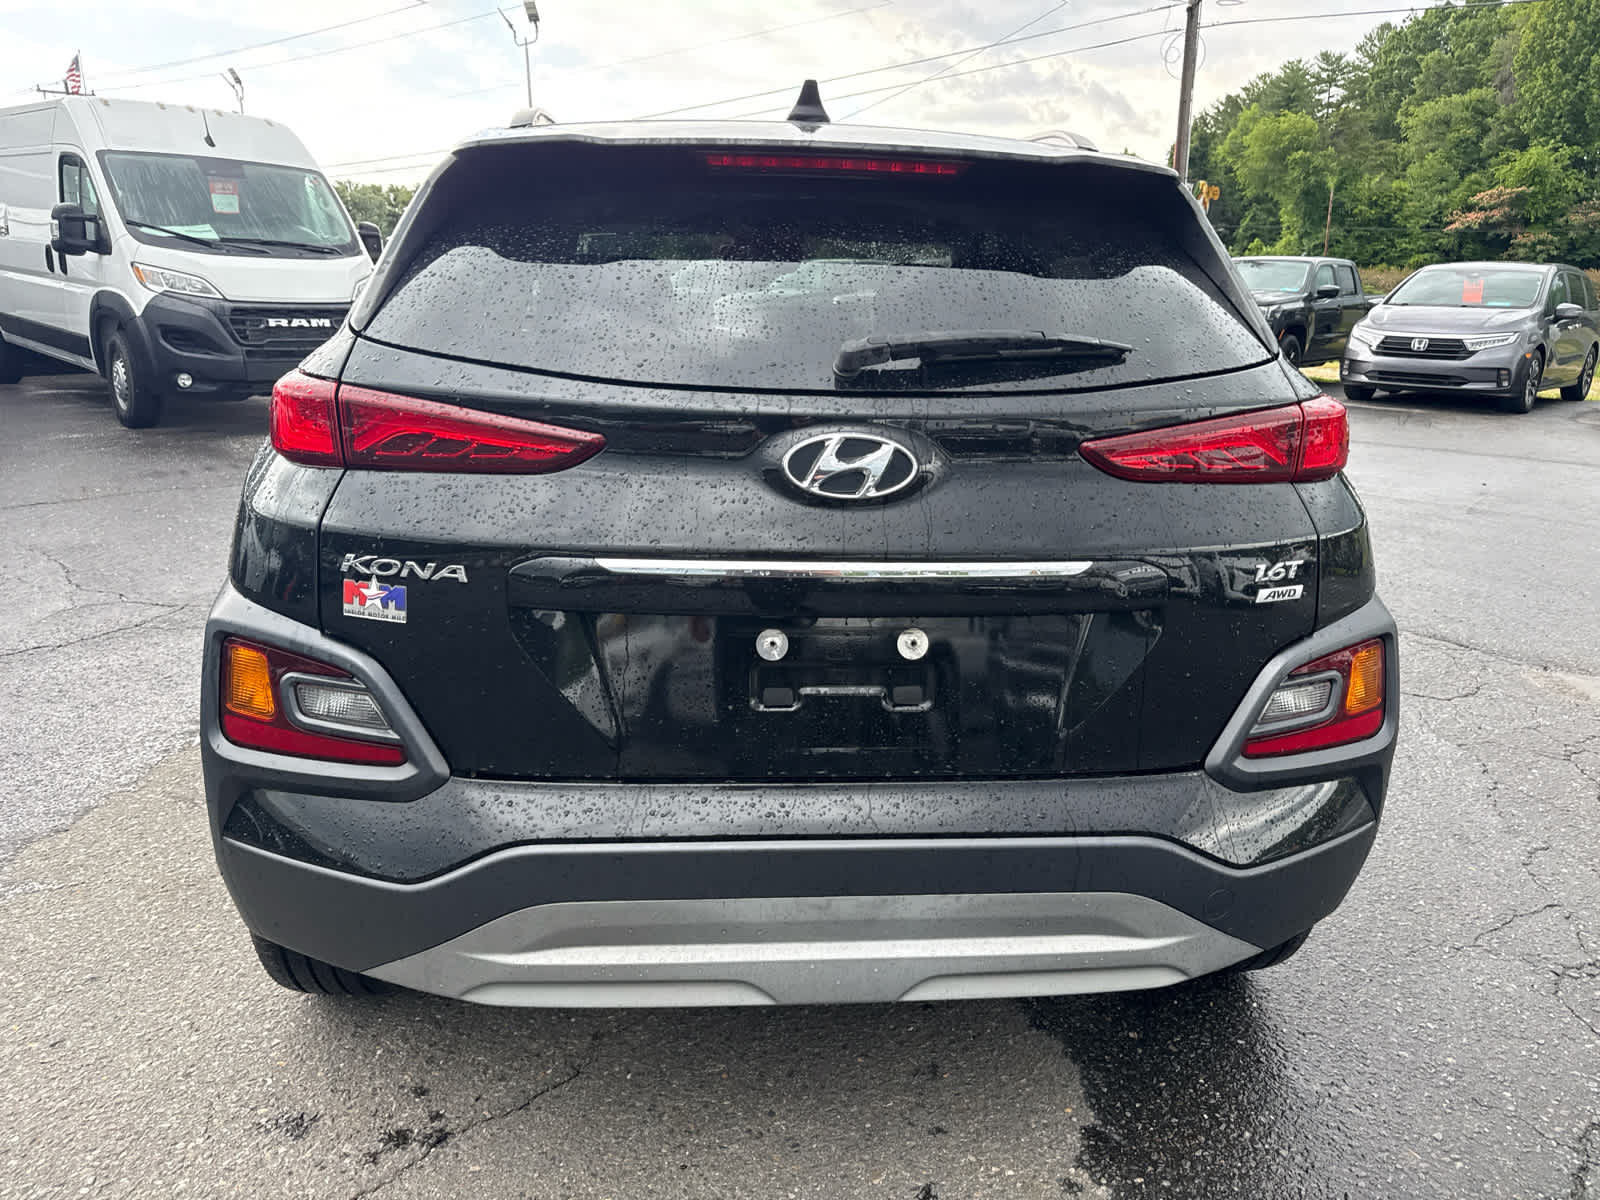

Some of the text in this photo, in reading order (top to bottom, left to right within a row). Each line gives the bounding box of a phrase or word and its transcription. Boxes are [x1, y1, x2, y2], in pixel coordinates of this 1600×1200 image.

[267, 318, 332, 328] RAM
[340, 553, 468, 583] KONA
[1263, 588, 1297, 601] AWD
